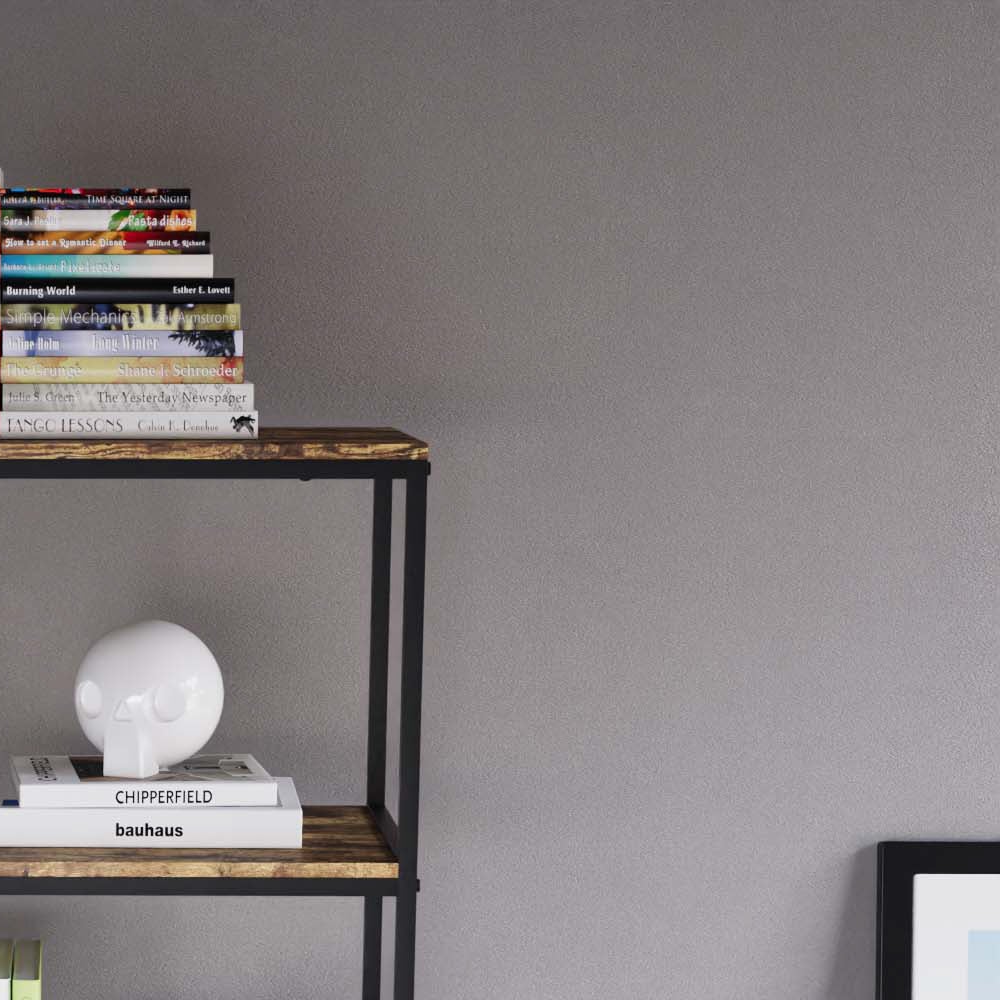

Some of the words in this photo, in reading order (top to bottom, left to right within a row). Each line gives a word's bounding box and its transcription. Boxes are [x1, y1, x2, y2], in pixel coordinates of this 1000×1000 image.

[86, 195, 106, 203] TIME
[110, 195, 142, 205] SQUARE
[159, 195, 189, 203] NIGHT
[127, 215, 158, 227] Pasta
[160, 215, 193, 227] dishes
[5, 238, 24, 248] How
[59, 238, 97, 248] Romantic
[99, 238, 127, 248] Dinner
[6, 286, 44, 298] Burning
[46, 285, 76, 296] World
[172, 285, 197, 294] Esther
[198, 286, 206, 294] E.
[207, 286, 231, 294] Lovett
[6, 308, 57, 327] Simple
[60, 308, 137, 324] Mechanics
[179, 311, 237, 325] Armstrong
[121, 334, 159, 351] Winter
[173, 363, 238, 377] Schroeder
[97, 391, 118, 403] The
[122, 391, 178, 408] Yesterday
[182, 391, 247, 407] Newspaper
[7, 418, 57, 433] TANGO
[61, 418, 124, 433] LESSONS
[115, 790, 213, 804] CHIPPERFIELD
[115, 823, 184, 838] bauhaus
